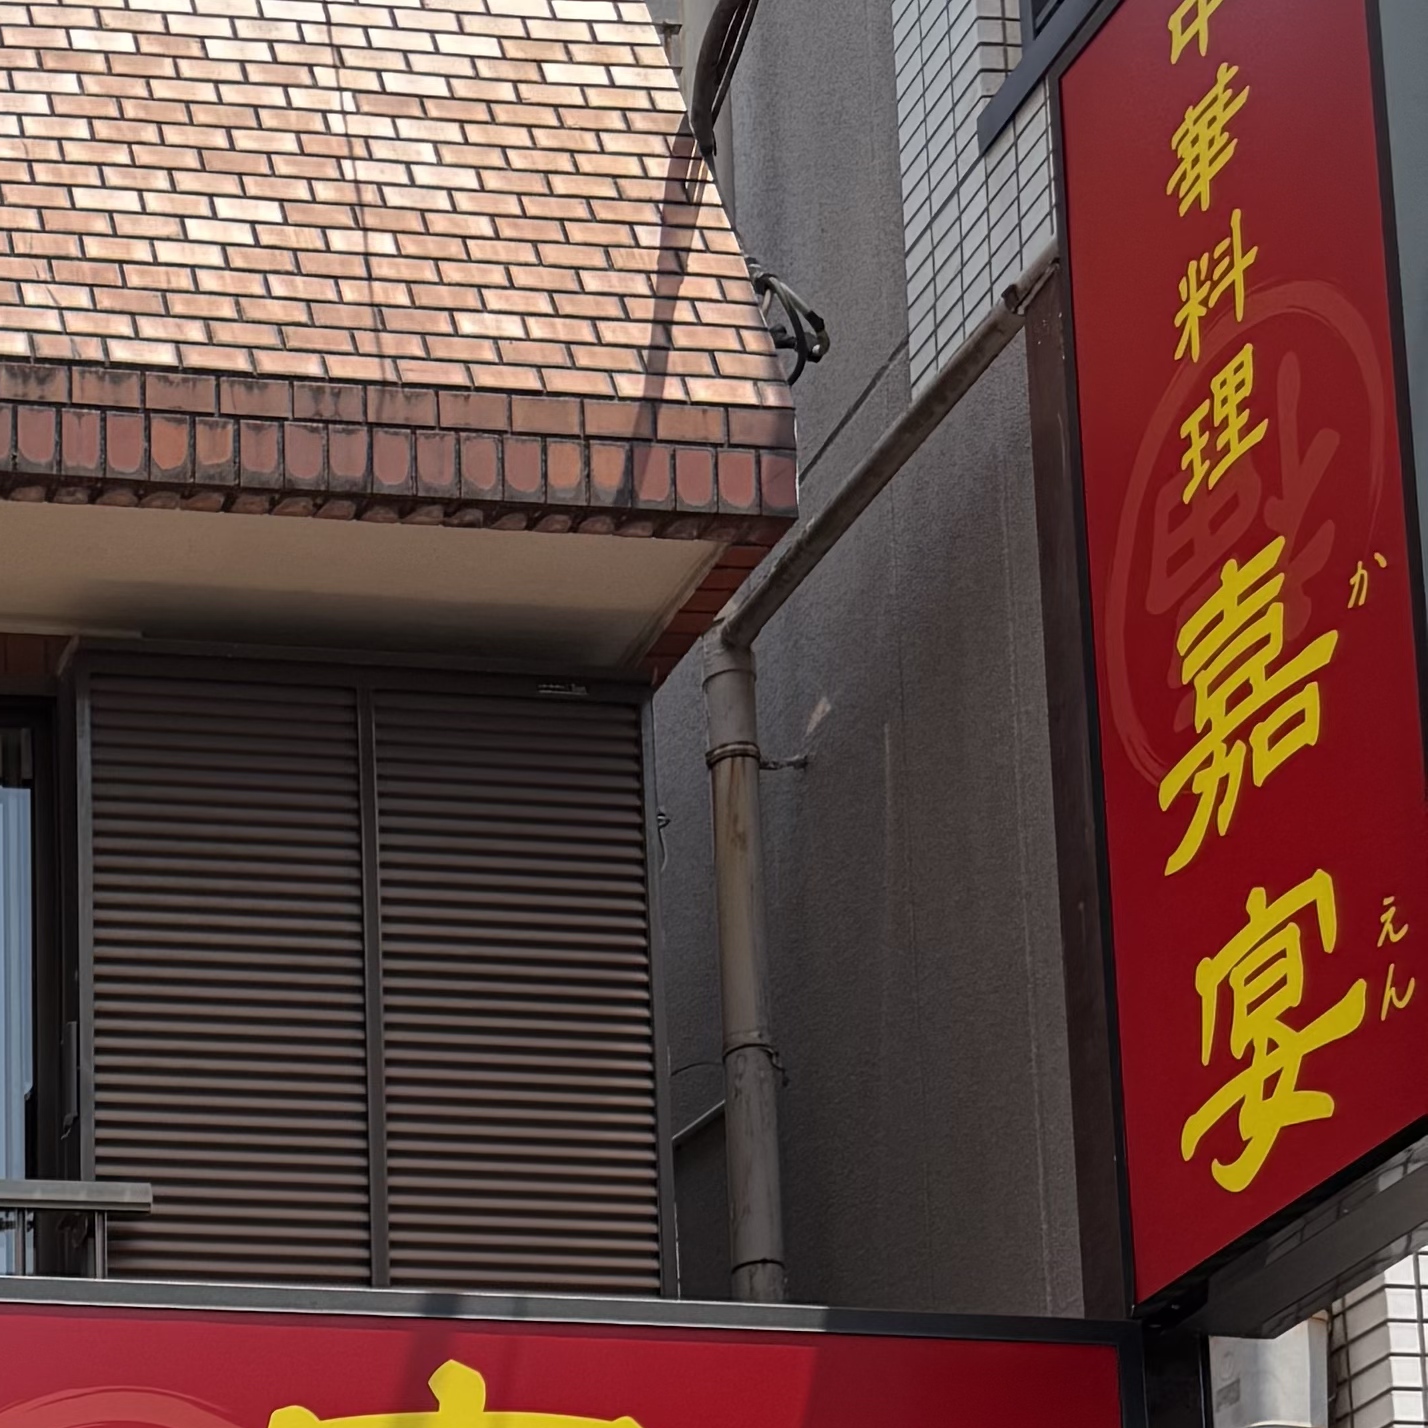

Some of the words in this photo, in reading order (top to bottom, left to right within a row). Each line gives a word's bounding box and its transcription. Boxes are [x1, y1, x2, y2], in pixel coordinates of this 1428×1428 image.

[1166, 0, 1267, 505] 中華料理
[1159, 536, 1366, 1193] 嘉宴
[1348, 552, 1388, 609] か
[1378, 896, 1414, 1022] えん
